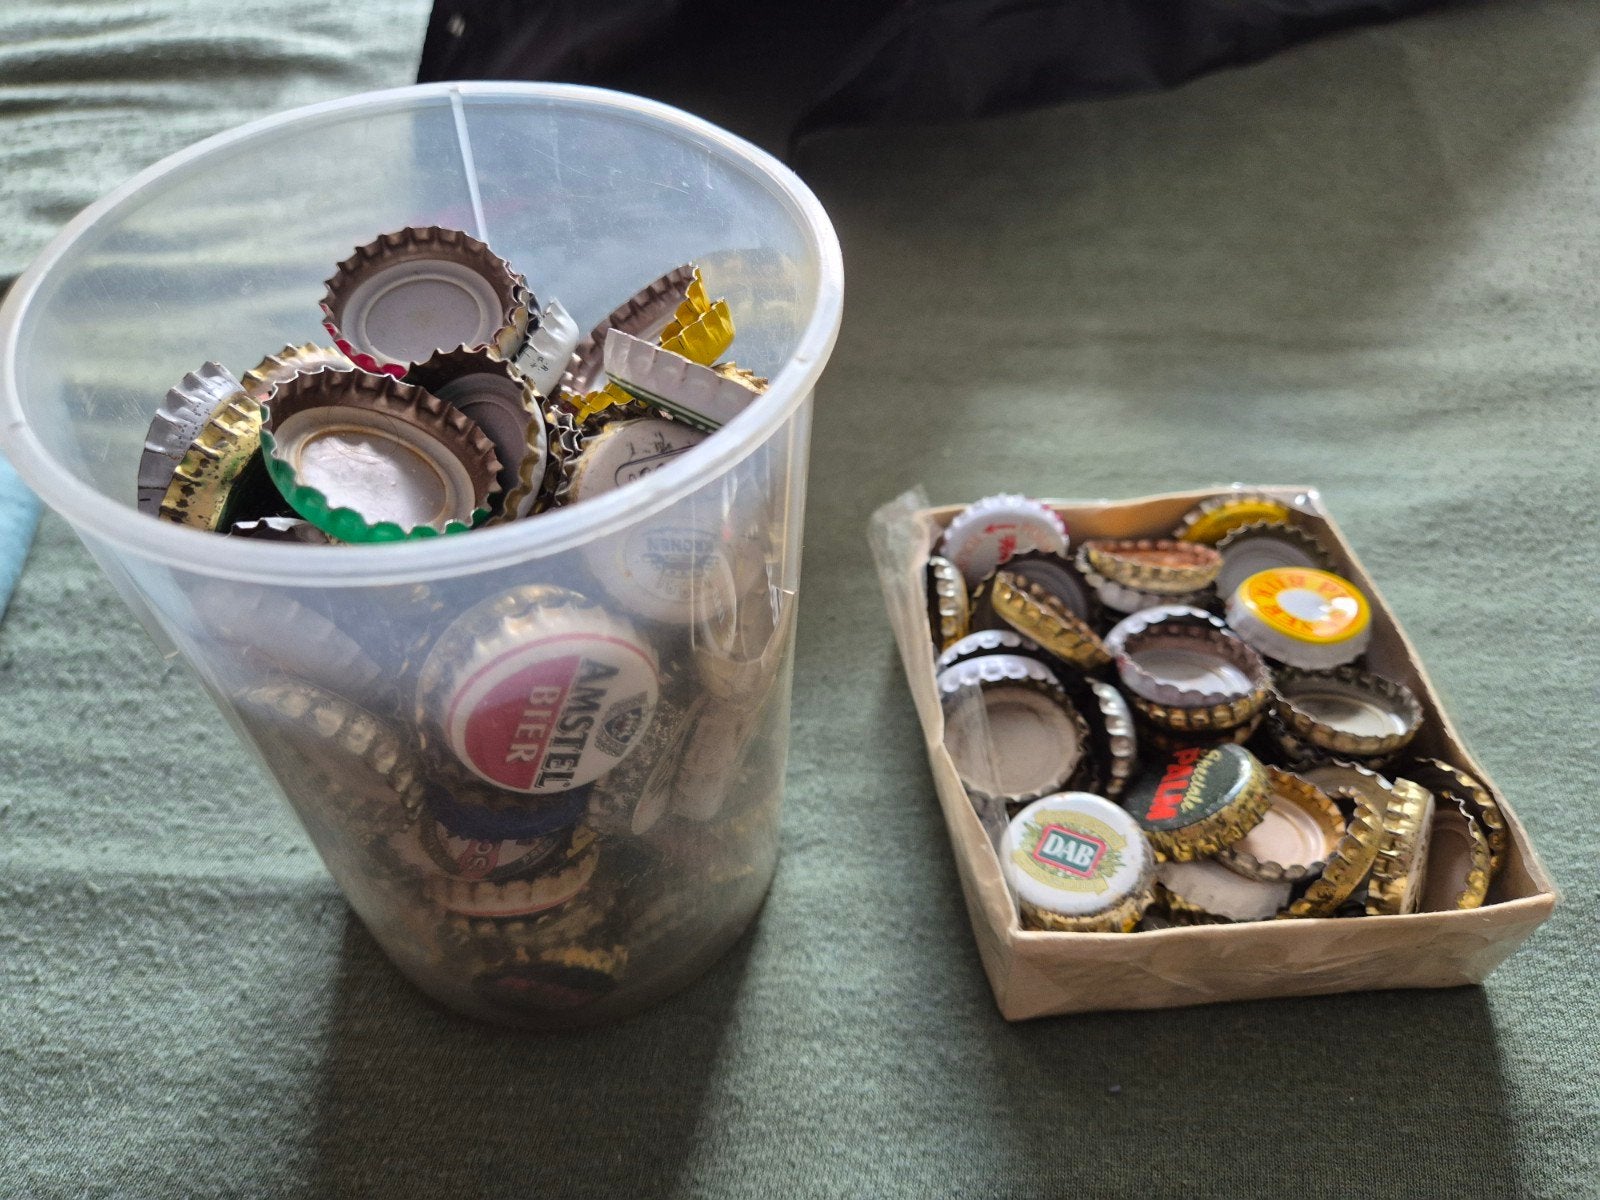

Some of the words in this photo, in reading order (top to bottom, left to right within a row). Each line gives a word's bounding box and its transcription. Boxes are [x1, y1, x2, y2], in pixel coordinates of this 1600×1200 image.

[505, 686, 562, 763] BIER
[535, 658, 620, 788] AMSTEL
[1146, 747, 1201, 820] PALM
[1042, 833, 1095, 867] DAB
